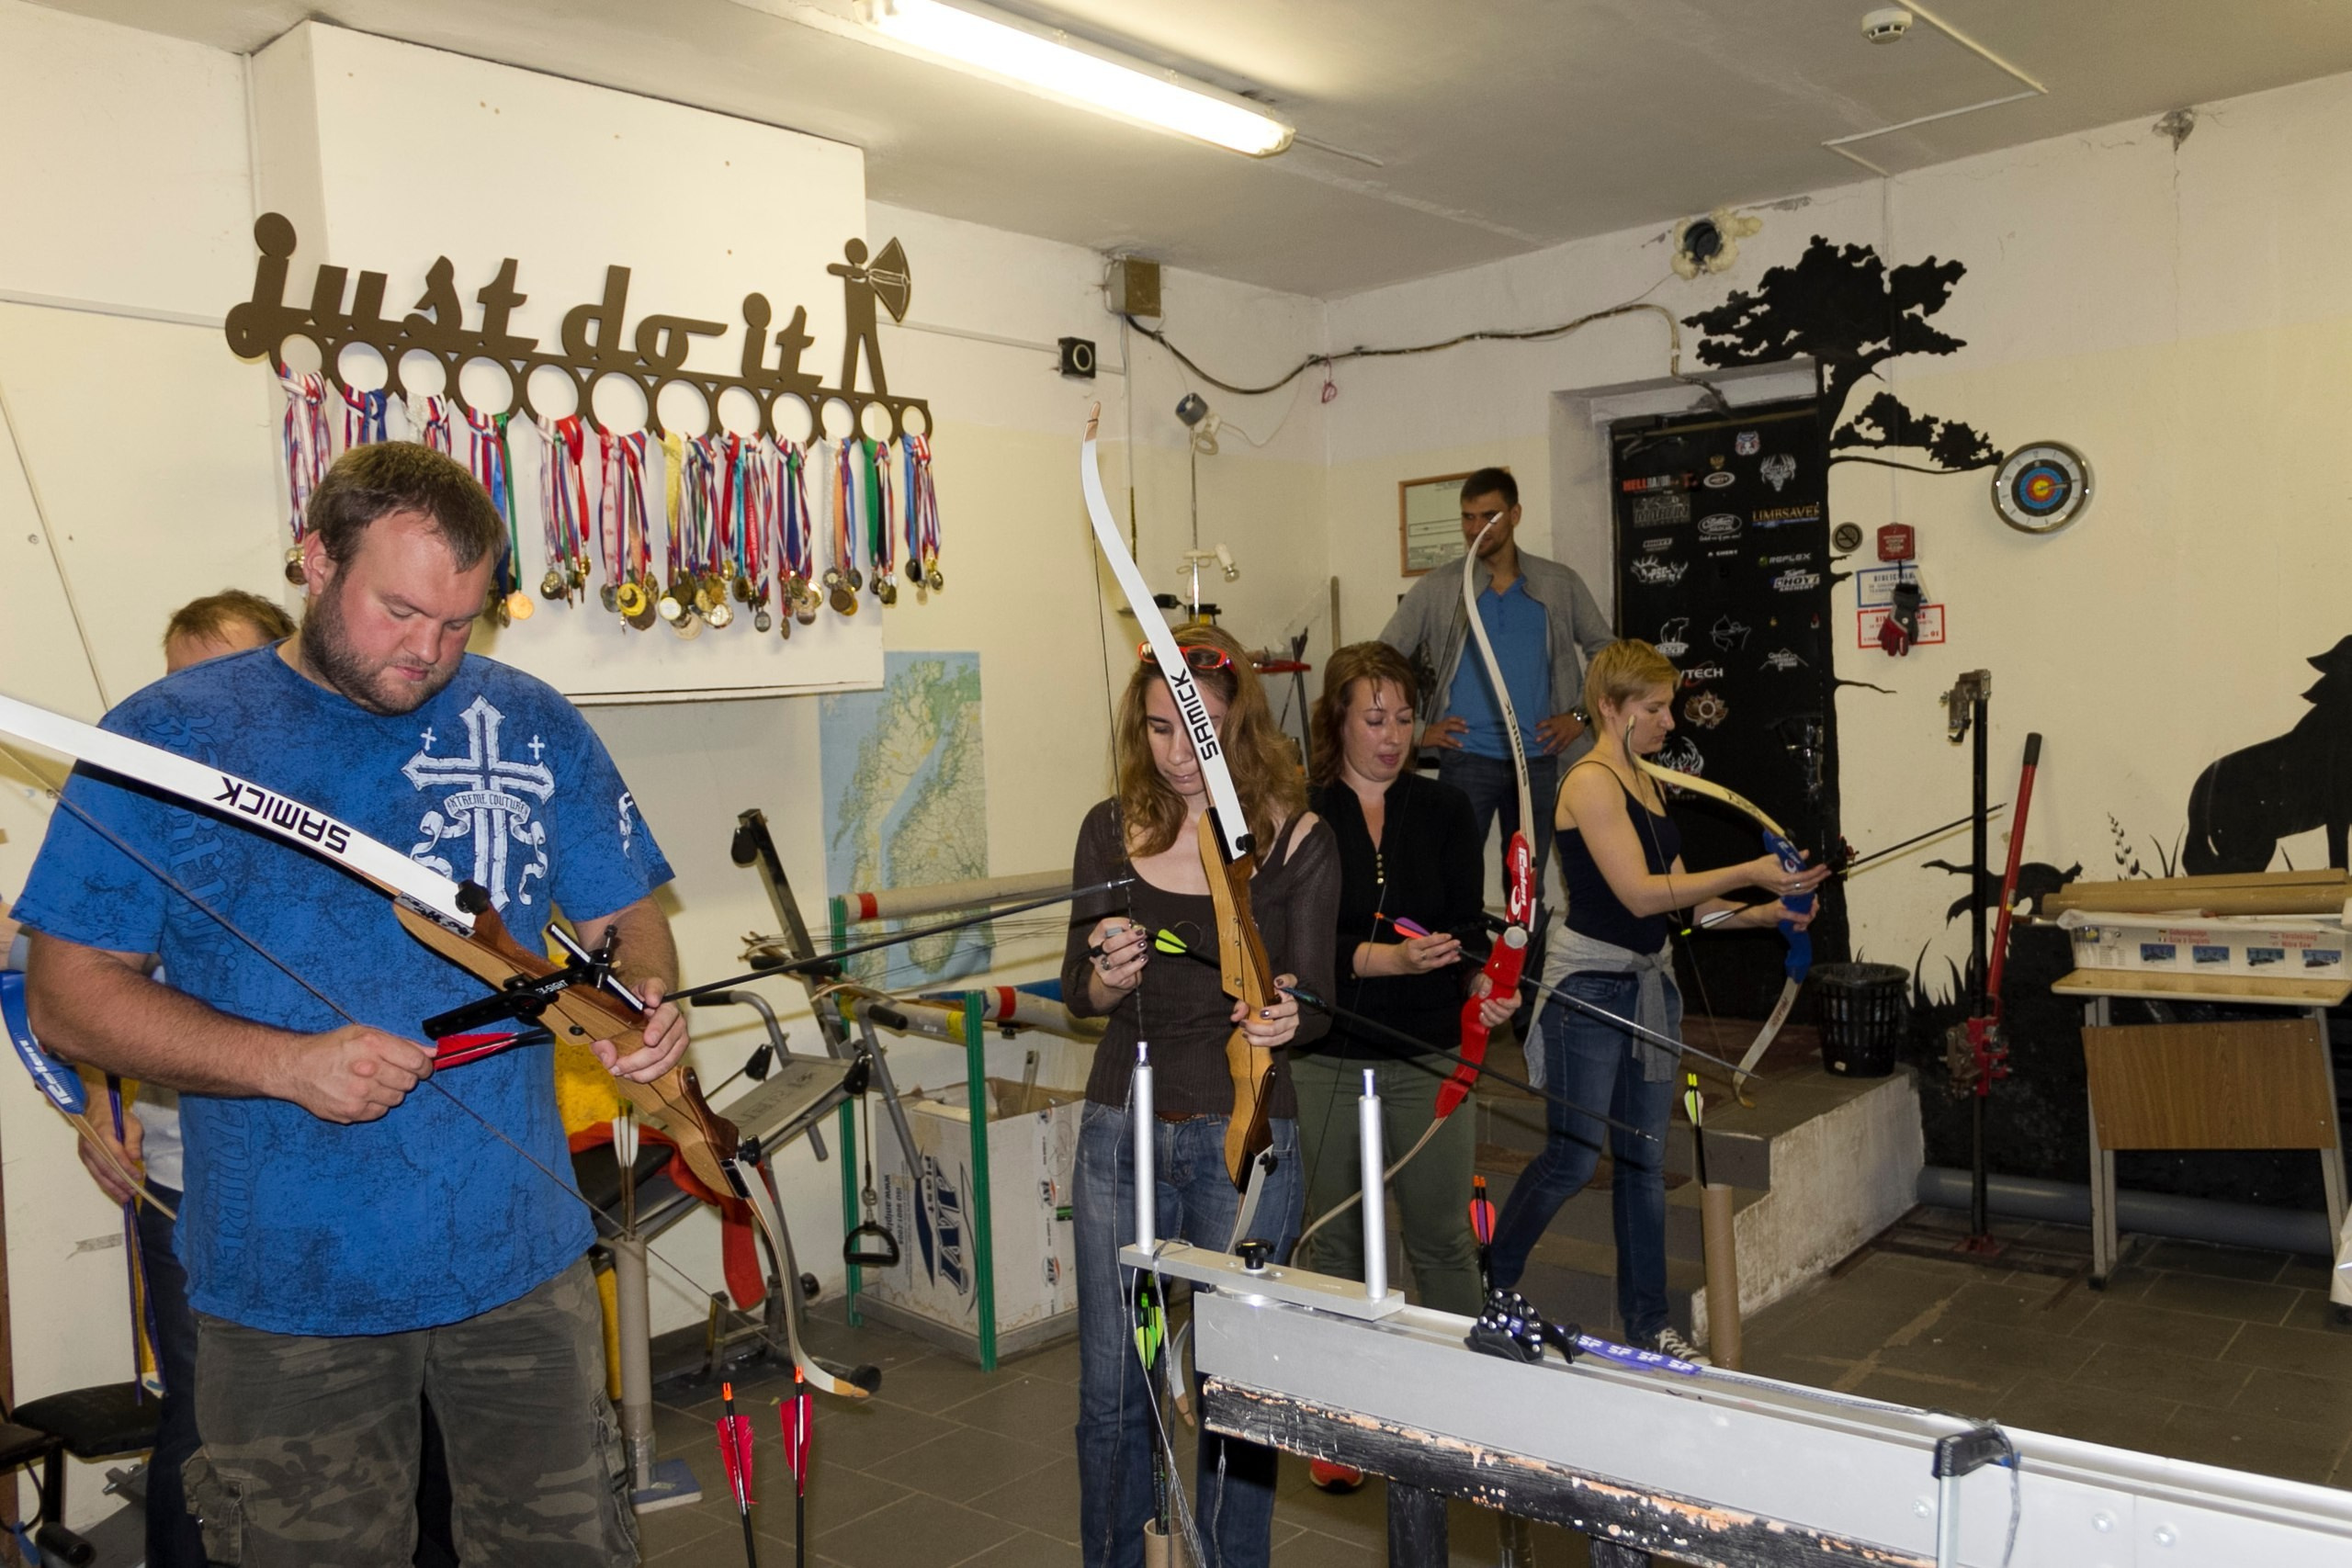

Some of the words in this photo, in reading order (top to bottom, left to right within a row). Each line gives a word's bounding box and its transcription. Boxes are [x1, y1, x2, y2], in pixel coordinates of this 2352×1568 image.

[225, 212, 538, 358] just
[561, 265, 727, 370] do
[742, 292, 822, 387] it
[1770, 553, 1811, 564] REFLEX
[1680, 668, 1724, 679] TECH
[1170, 669, 1219, 761] SAMICK
[1505, 702, 1528, 787] SAMICK
[213, 775, 352, 855] SAMICK
